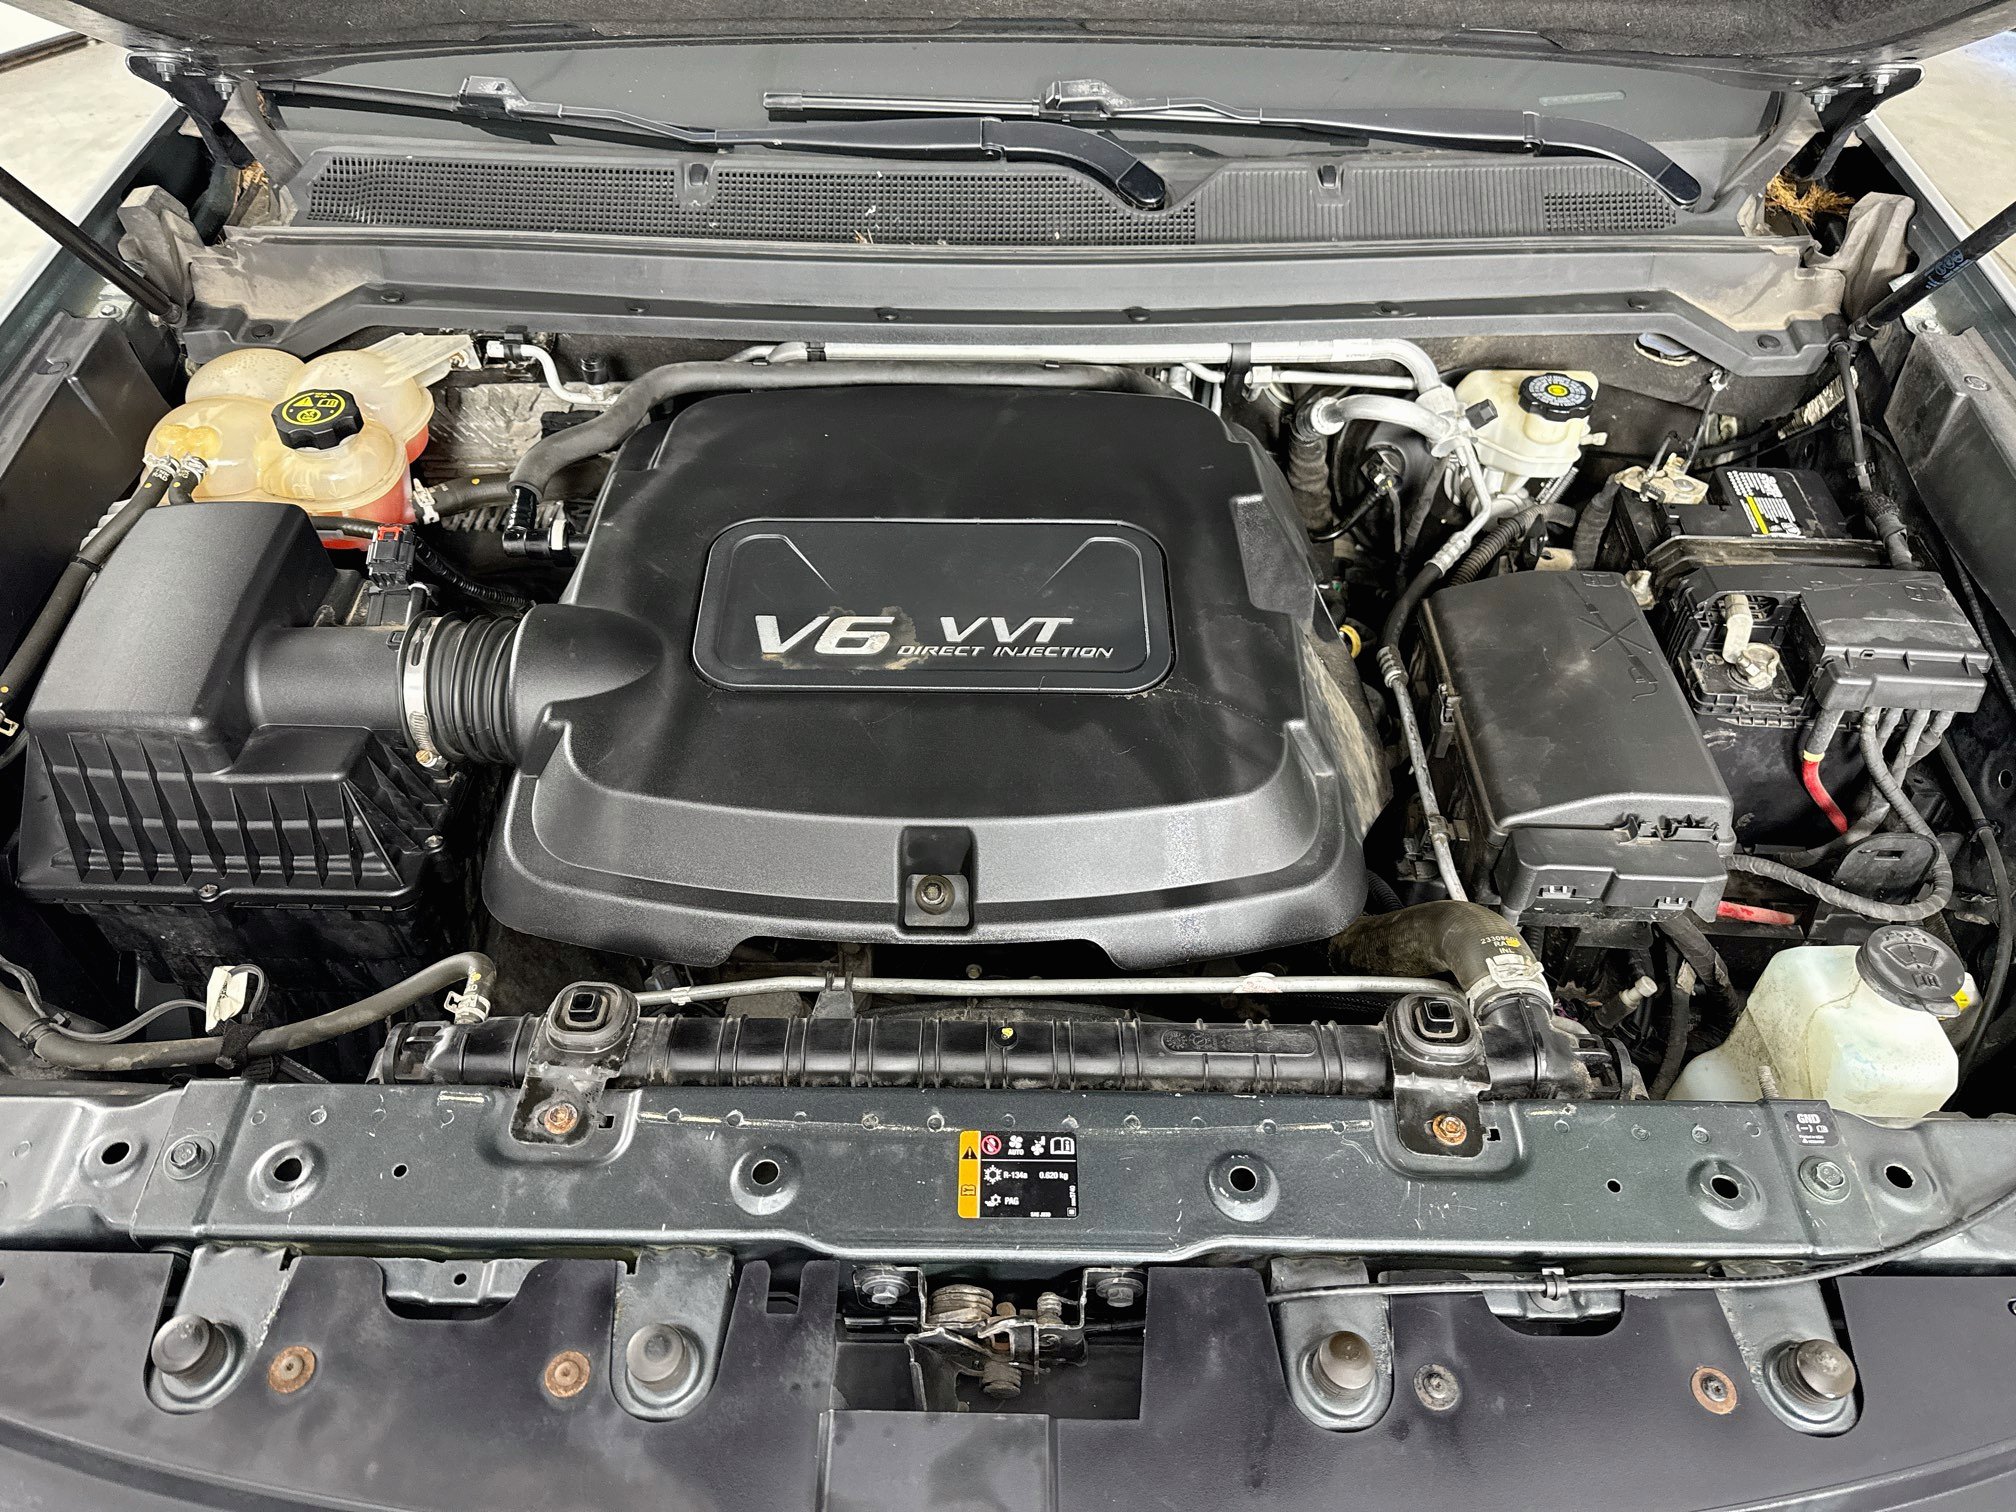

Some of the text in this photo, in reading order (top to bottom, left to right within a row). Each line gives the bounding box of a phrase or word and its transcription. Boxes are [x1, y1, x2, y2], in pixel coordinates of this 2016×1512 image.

[939, 616, 1075, 643] VVT
[754, 615, 896, 656] V6
[896, 645, 1114, 659] DIRECT INJECTION
[1796, 1113, 1821, 1124] GND
[1007, 1148, 1025, 1156] AUTO
[1003, 1171, 1028, 1179] R-134a
[1059, 1171, 1069, 1180] kg
[1004, 1197, 1020, 1205] PAG
